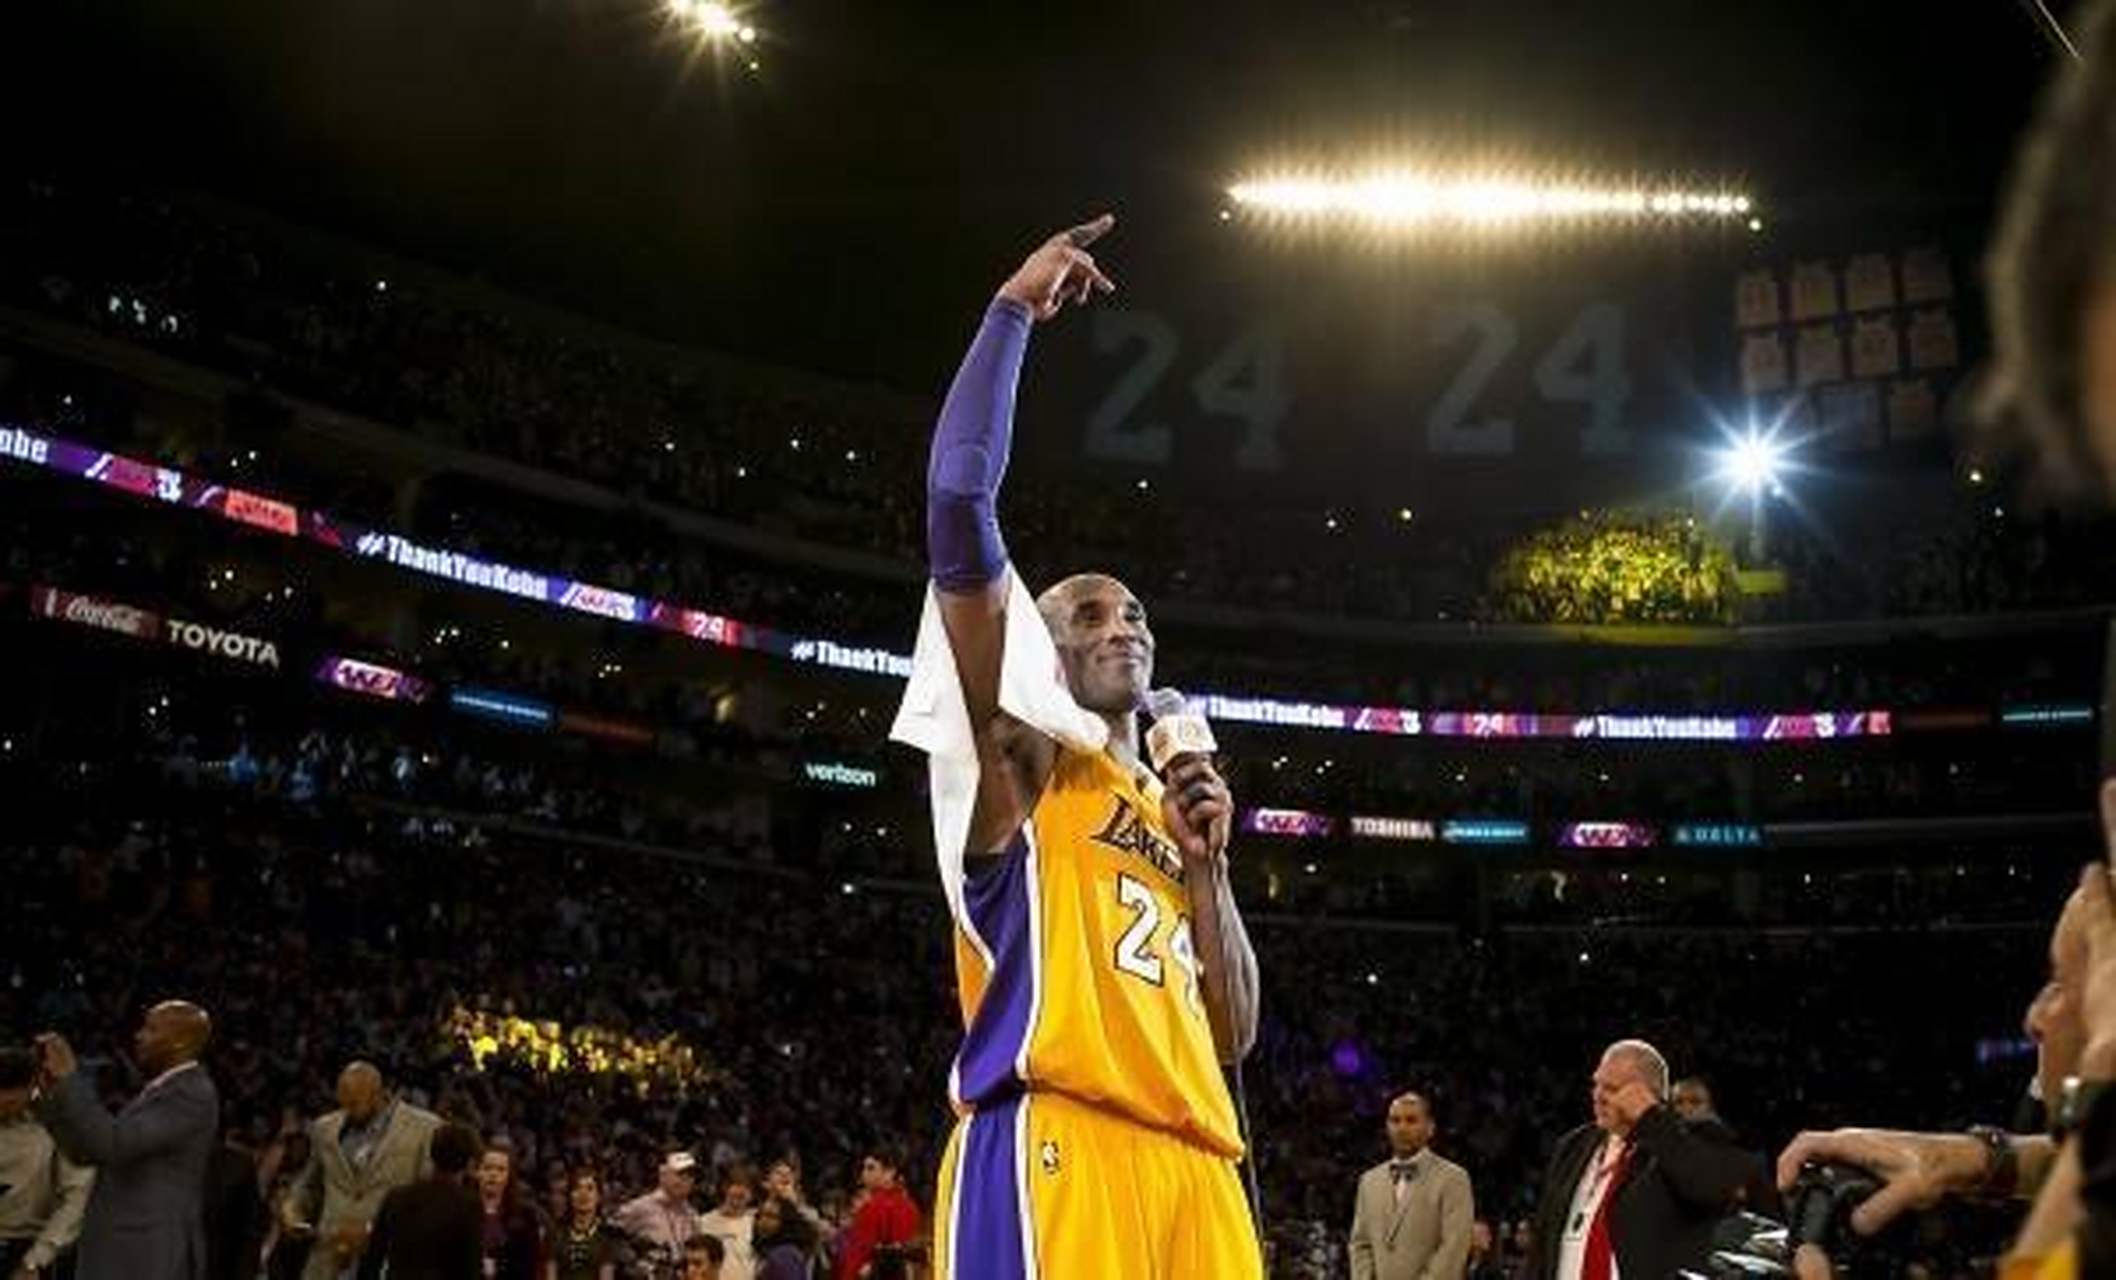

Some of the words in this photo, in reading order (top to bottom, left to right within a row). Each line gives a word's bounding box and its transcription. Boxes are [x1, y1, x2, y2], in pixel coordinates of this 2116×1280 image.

[1427, 303, 1637, 456] 24
[166, 619, 280, 668] TOYOTA
[805, 762, 876, 787] verizon
[1350, 817, 1434, 841] TOSHIBA
